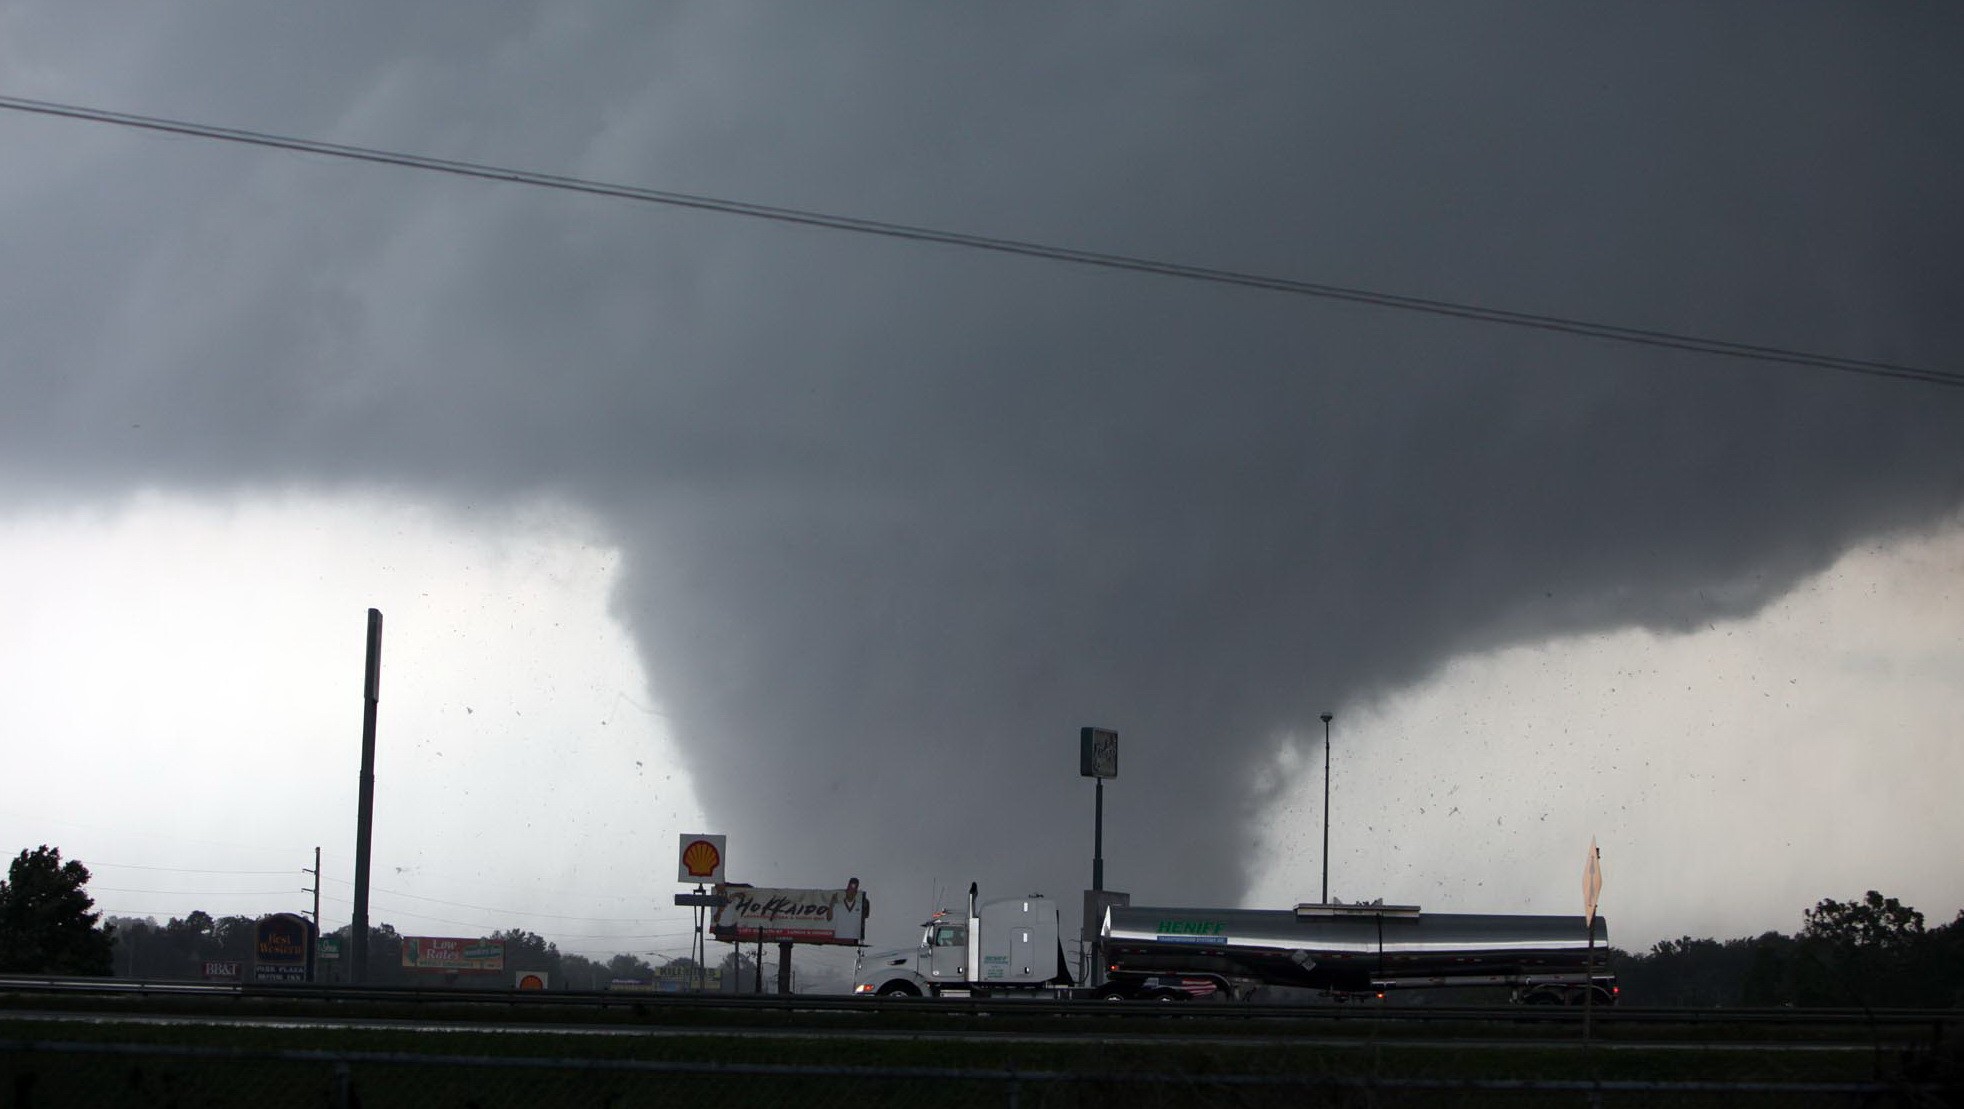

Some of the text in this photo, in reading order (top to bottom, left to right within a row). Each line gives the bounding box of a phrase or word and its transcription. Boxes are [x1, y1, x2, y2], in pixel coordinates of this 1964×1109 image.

[734, 895, 829, 921] HOKKAIDO
[1157, 919, 1227, 934] HENIFF
[268, 933, 290, 945] Best
[433, 939, 458, 949] Low
[259, 943, 302, 955] Western
[426, 948, 460, 960] Rates
[205, 962, 238, 976] BB&T
